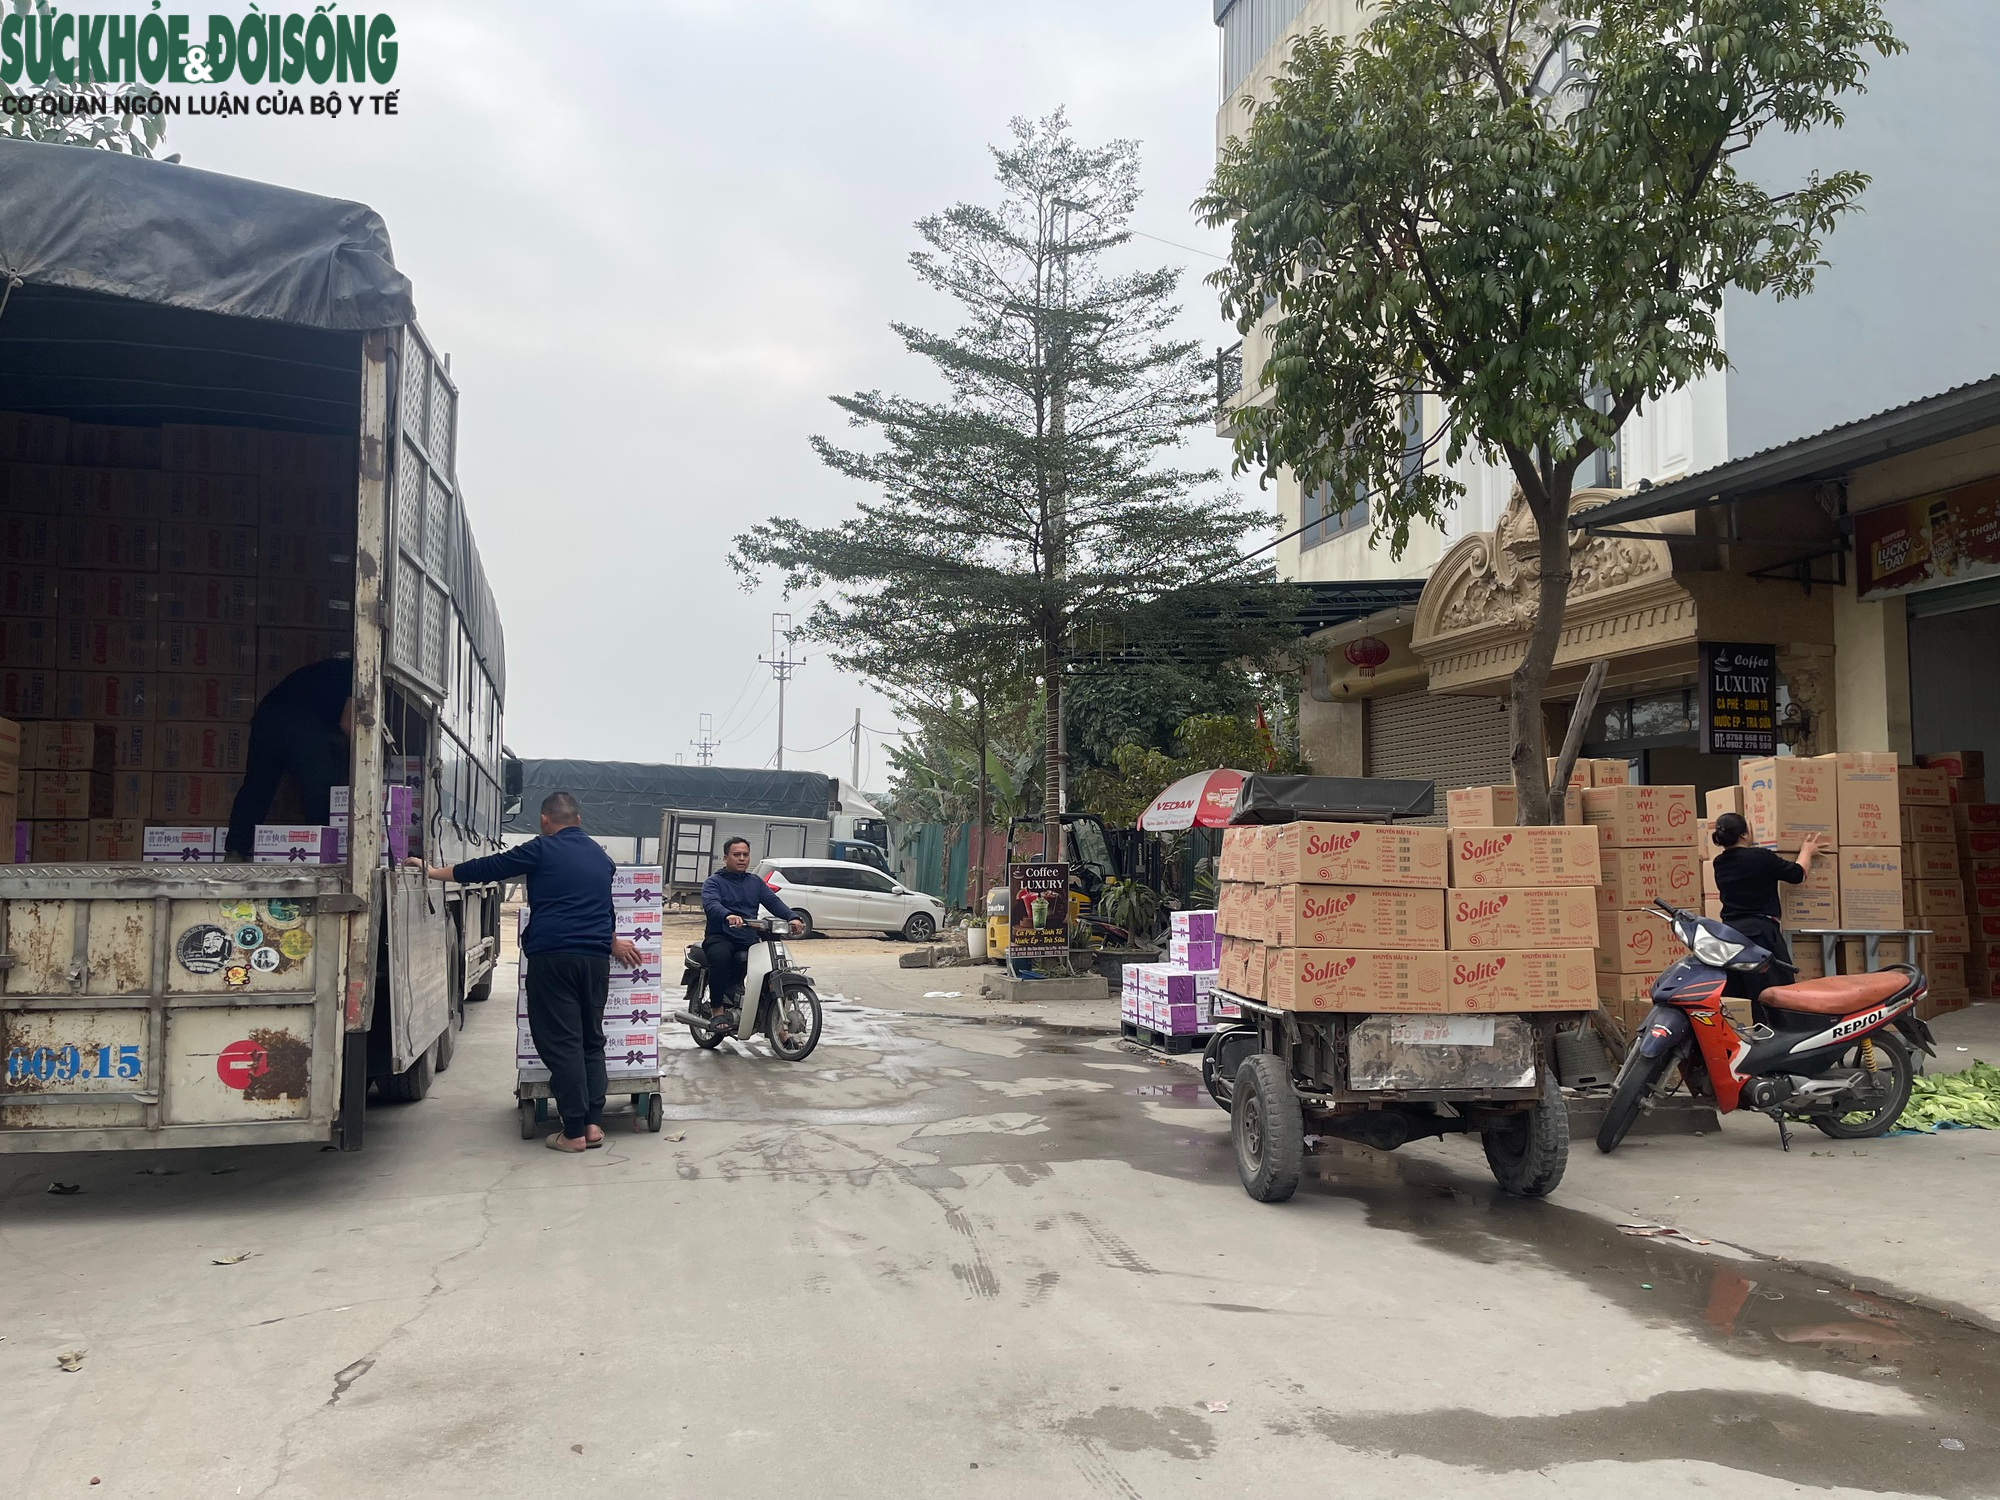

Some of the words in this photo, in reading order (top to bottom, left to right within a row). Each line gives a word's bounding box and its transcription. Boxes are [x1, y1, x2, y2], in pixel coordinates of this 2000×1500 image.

[1971, 520, 1998, 536] THƠM
[1878, 537, 1912, 566] LUCKY
[1884, 552, 1906, 571] DAY
[1734, 654, 1769, 668] Coffee
[1715, 675, 1770, 693] LUXURY
[1717, 696, 1725, 709] CÀ
[1727, 697, 1739, 710] PHÊ
[1744, 699, 1759, 710] SINH
[1732, 714, 1740, 728] ÉP
[1746, 715, 1758, 728] TRÀ
[1795, 785, 1818, 793] Đoàn
[1796, 793, 1817, 802] Viên
[1860, 803, 1880, 811] Viên
[1858, 812, 1881, 820] Đoàn
[1307, 835, 1352, 854] Solite
[1461, 840, 1504, 861] Solite
[1026, 867, 1058, 878] Coffee
[1850, 862, 1867, 870] Bánh
[1020, 880, 1064, 889] LUXURY
[1303, 899, 1347, 918] Solite
[1456, 901, 1500, 922] Solite
[1935, 933, 1946, 943] Bốn
[1301, 963, 1345, 983] Solite
[1453, 964, 1498, 985] Solite
[1833, 1011, 1884, 1038] REPSOL
